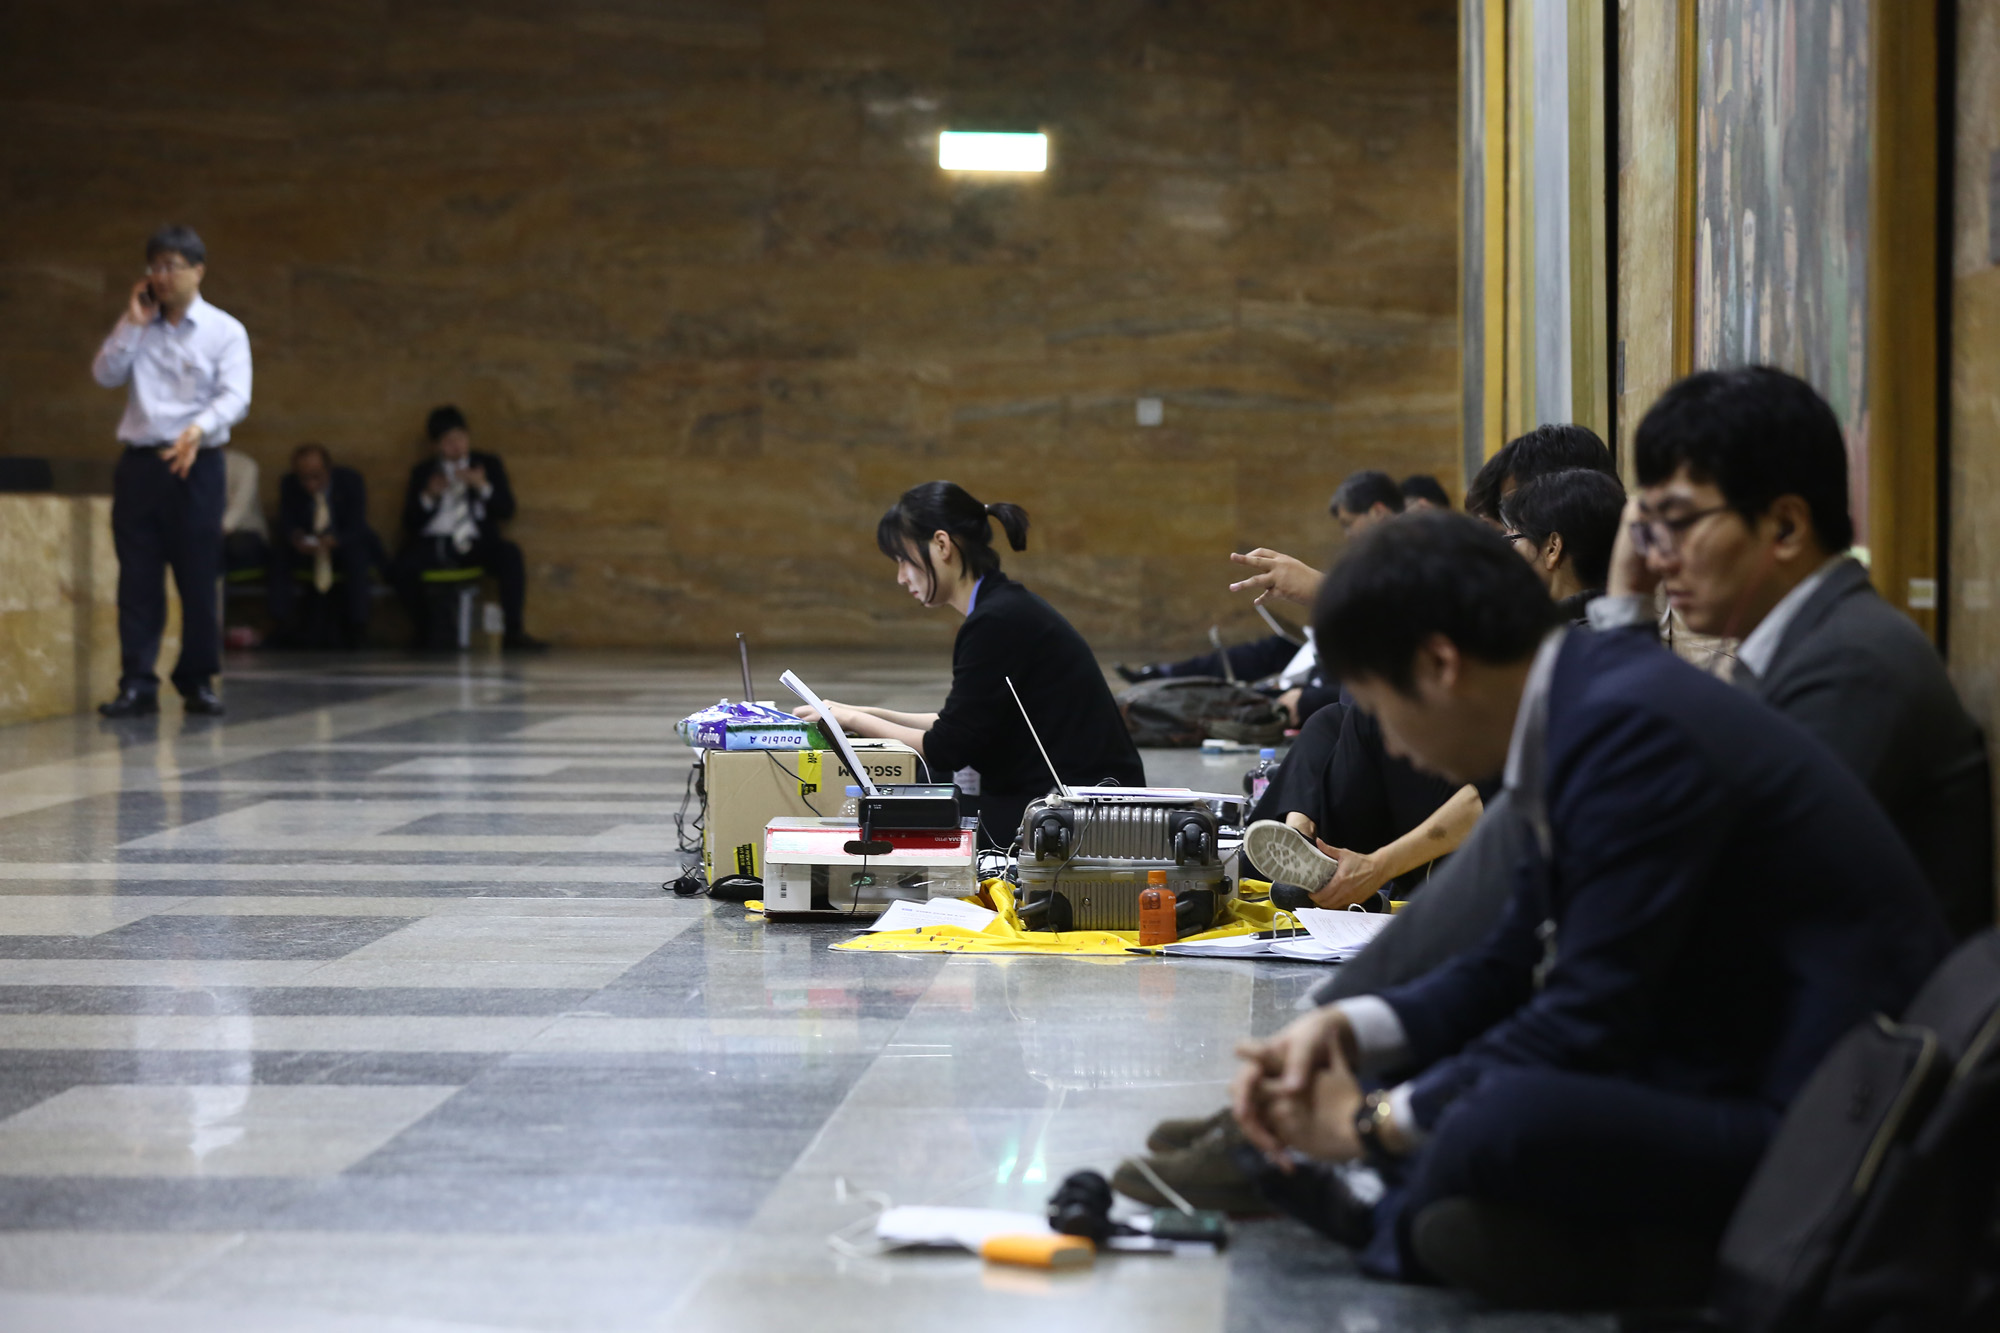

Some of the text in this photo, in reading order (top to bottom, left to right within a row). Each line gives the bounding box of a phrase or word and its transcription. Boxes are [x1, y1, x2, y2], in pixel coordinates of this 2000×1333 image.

[750, 736, 802, 744] Double A
[838, 765, 902, 777] SSG.CM
